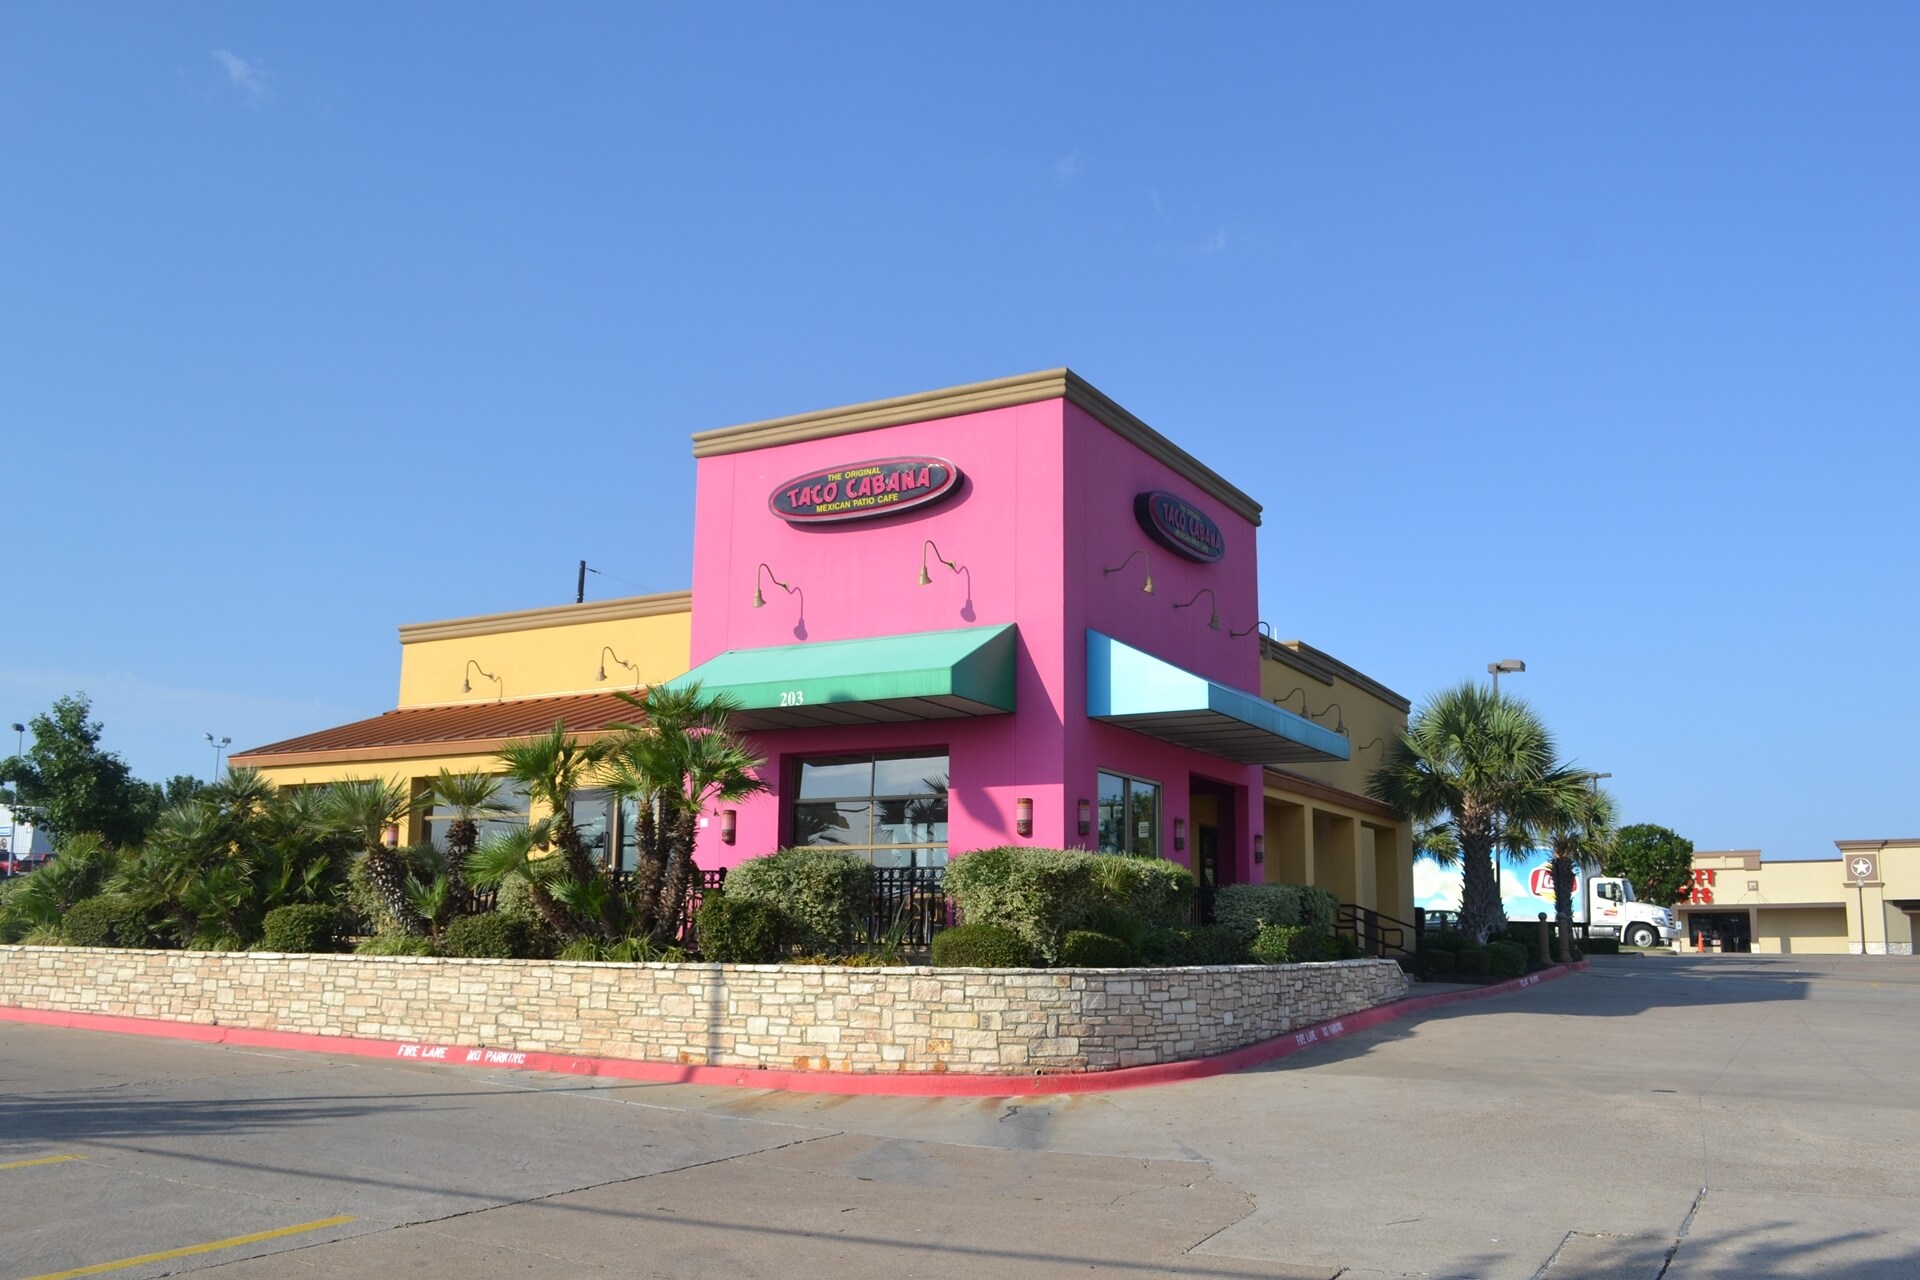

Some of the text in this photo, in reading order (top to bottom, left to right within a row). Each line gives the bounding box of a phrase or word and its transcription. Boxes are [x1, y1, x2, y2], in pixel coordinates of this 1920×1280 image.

[828, 467, 881, 482] THE ORIGINAL
[787, 468, 931, 508] TACO CABANA
[816, 493, 898, 513] MEXICAN PATIO CAFE
[1162, 502, 1186, 532] TACO
[1189, 517, 1221, 550] CABANA
[780, 690, 804, 707] 203
[397, 1044, 448, 1058] FIRE LANE
[466, 1049, 526, 1064] NO PARKING
